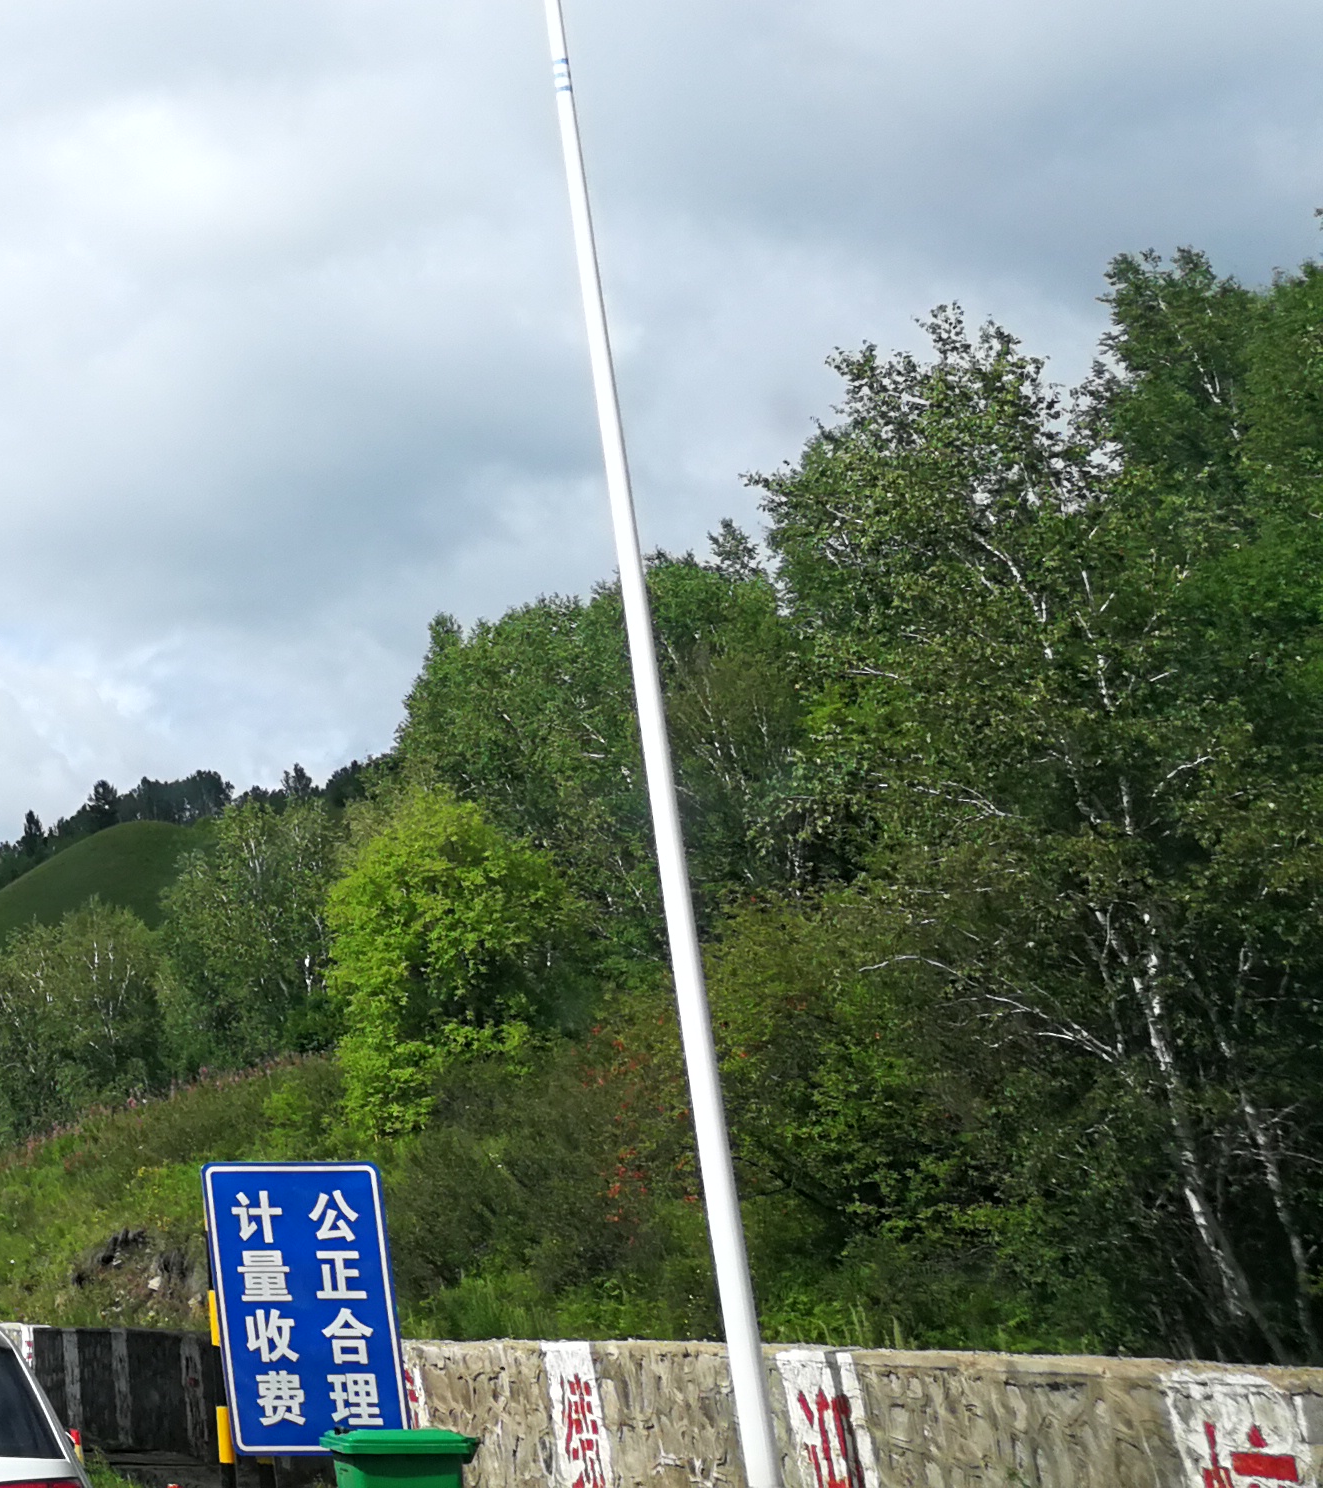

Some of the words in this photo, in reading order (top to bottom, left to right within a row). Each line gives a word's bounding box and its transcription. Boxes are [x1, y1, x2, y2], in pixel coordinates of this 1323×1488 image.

[231, 1191, 307, 1426] 计量收费
[309, 1189, 385, 1427] 公正合理
